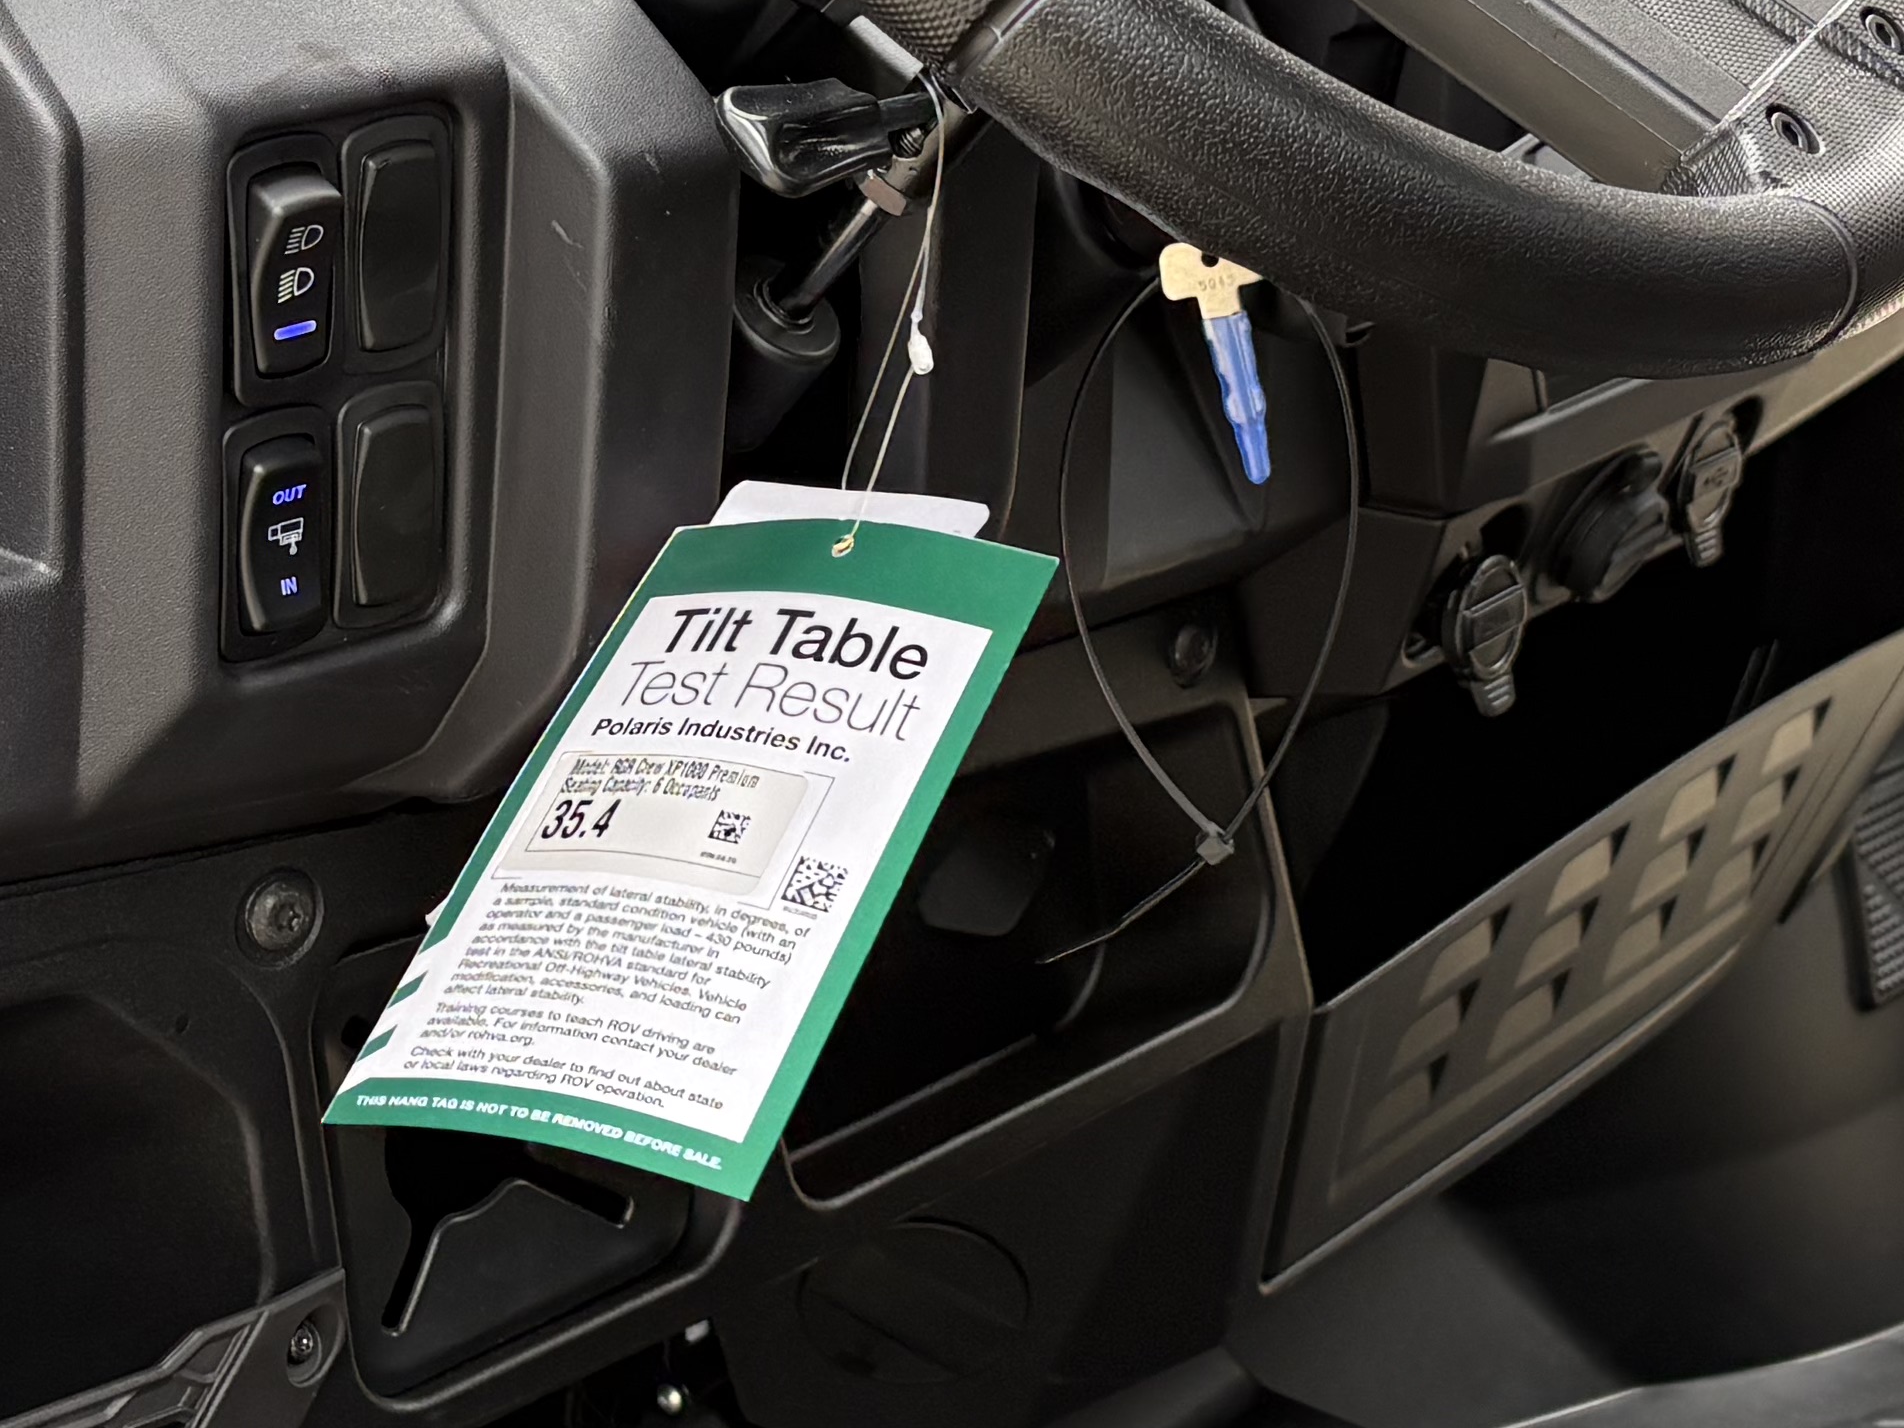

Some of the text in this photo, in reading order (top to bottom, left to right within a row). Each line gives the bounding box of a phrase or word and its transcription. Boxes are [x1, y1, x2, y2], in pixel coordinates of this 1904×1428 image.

[272, 483, 308, 506] OUT
[280, 577, 298, 596] IN
[665, 608, 928, 680] Tilt Table
[621, 661, 920, 741] Test Result
[591, 717, 850, 762] Polaris Industries Inc.
[708, 765, 761, 788] Premium
[541, 799, 621, 839] 35.4
[500, 883, 588, 894] Measurement
[592, 885, 608, 896] of
[610, 886, 653, 902] lateral
[714, 905, 727, 916] in
[731, 909, 789, 934] degrees,
[795, 926, 811, 938] of
[559, 897, 619, 912] standard
[622, 901, 686, 922] condition
[690, 916, 738, 934] vehicle
[740, 925, 775, 943] (with
[779, 938, 796, 950] an
[472, 934, 770, 989] accordance with the tilt table lateral stability
[479, 922, 720, 958] as measured by the manufacturer in
[486, 909, 792, 965] operator and passenger load 430 pounds)
[444, 984, 483, 994] affect
[485, 984, 526, 996] lateral
[458, 958, 747, 1011] Recreational Off-Highway Vehicles. Vehicle
[465, 947, 711, 985] test in the ANSI/ROHVA standard for
[451, 972, 740, 1024] modification, accessories, and loading can
[419, 1027, 535, 1046] and/or rohva.org.
[427, 1015, 737, 1075] available. For information contact your dealer
[436, 1002, 715, 1054] Training courses to teach ROV driving are
[404, 1059, 664, 1108] or local laws regarding ROV operation.
[411, 1046, 723, 1109] Check with your dealer to find out about state
[357, 1095, 723, 1170] THIS HANG TAG IS NOT TO BE REMOVED BEFORE SALE.
